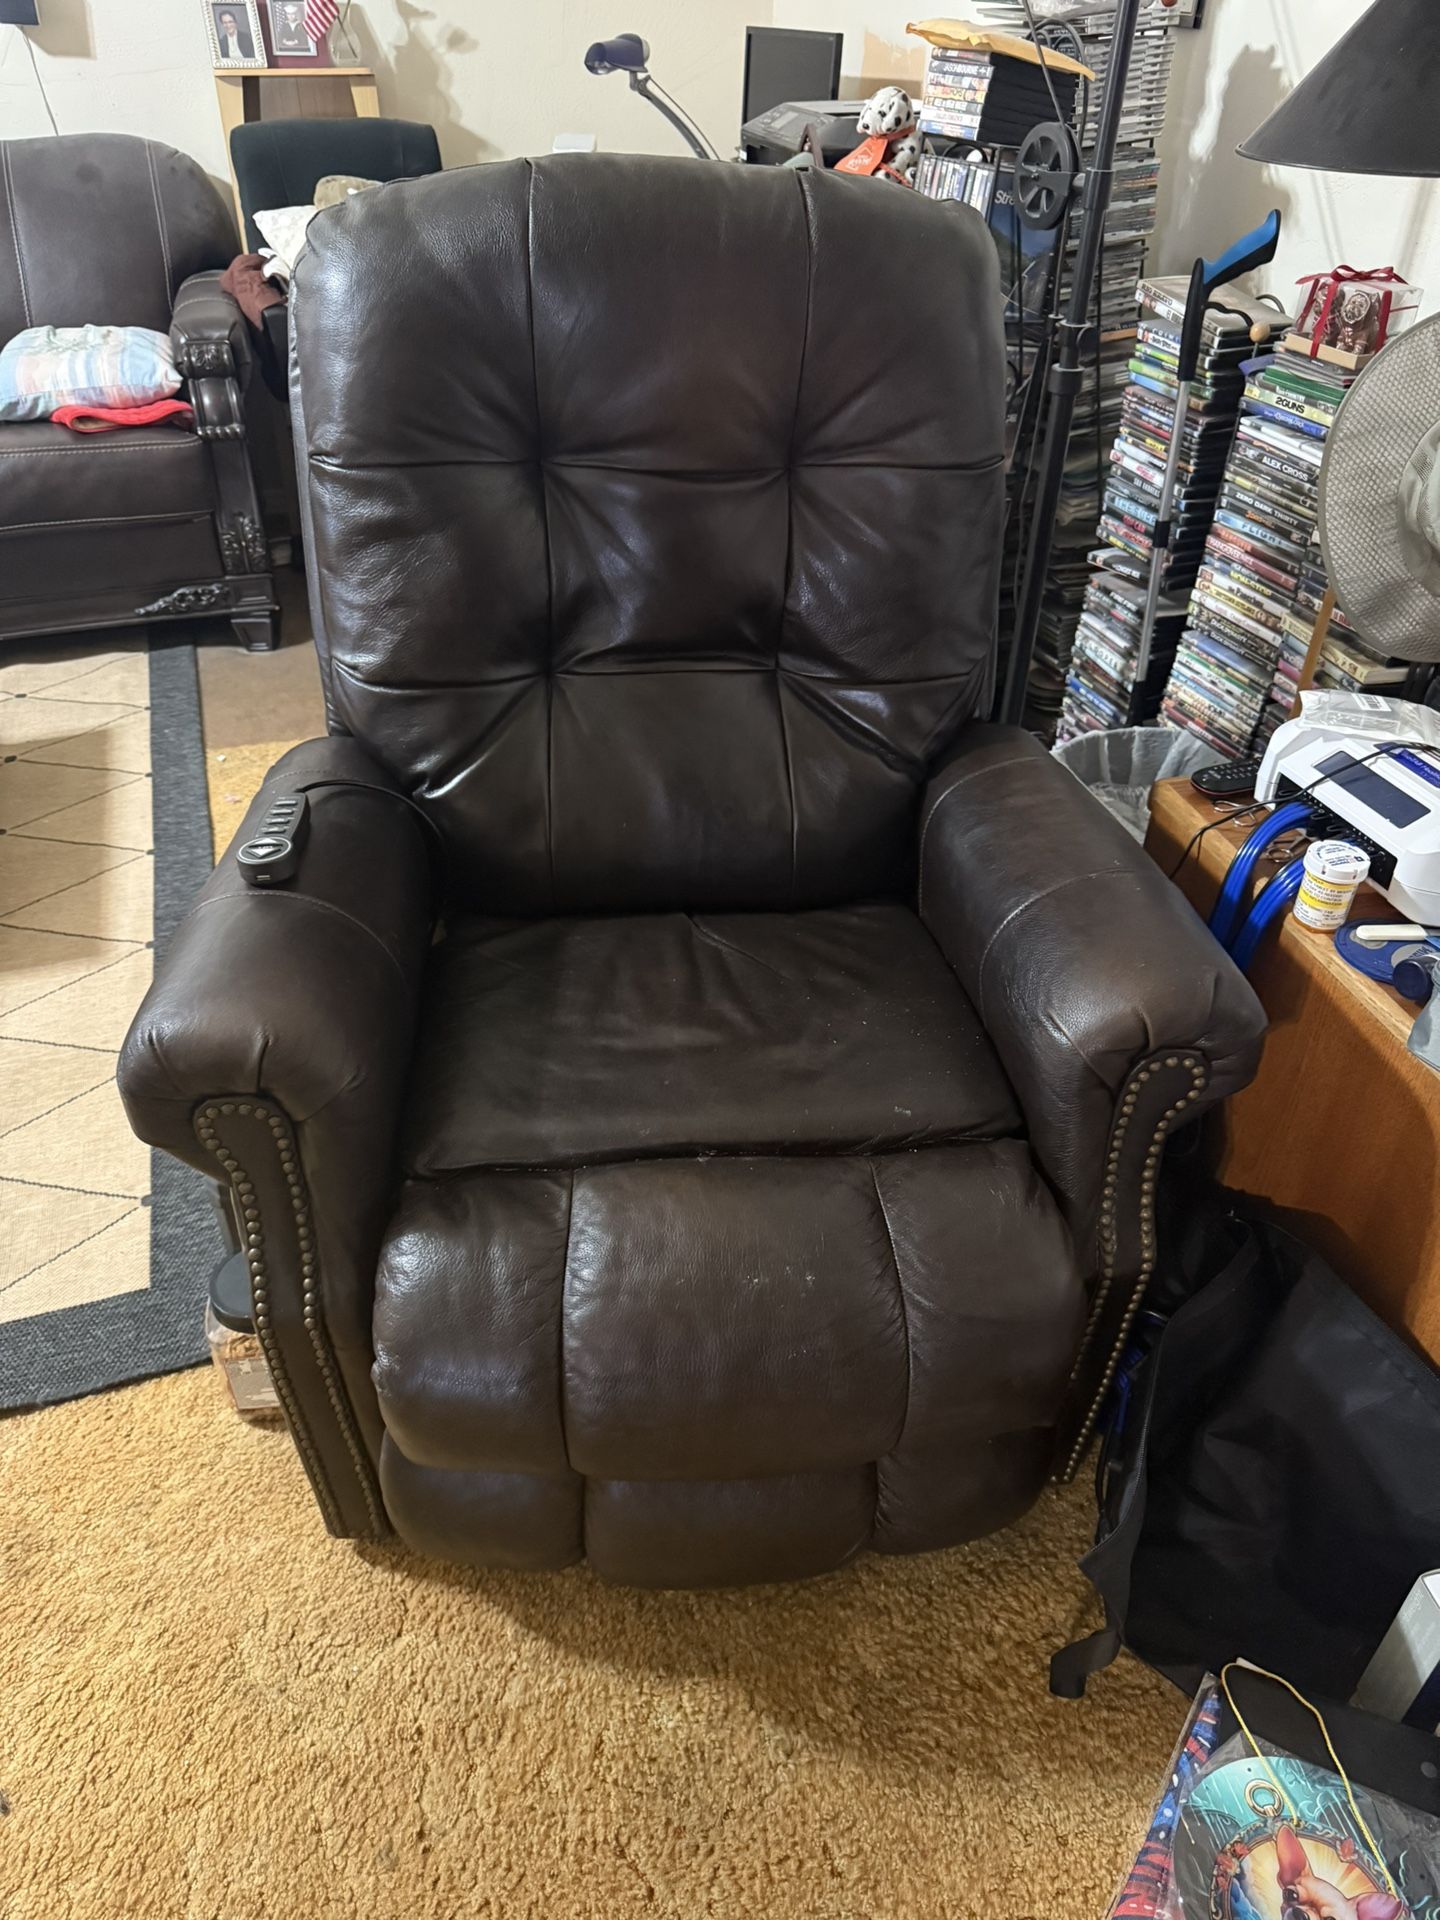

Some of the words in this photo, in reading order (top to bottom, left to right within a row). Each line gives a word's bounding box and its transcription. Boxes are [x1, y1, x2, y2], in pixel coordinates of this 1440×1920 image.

[1262, 455, 1281, 470] ALEX
[1282, 464, 1309, 481] CROSS
[1235, 492, 1254, 505] ZERO
[1254, 500, 1273, 514] DARK
[1273, 509, 1299, 526] THIRTY
